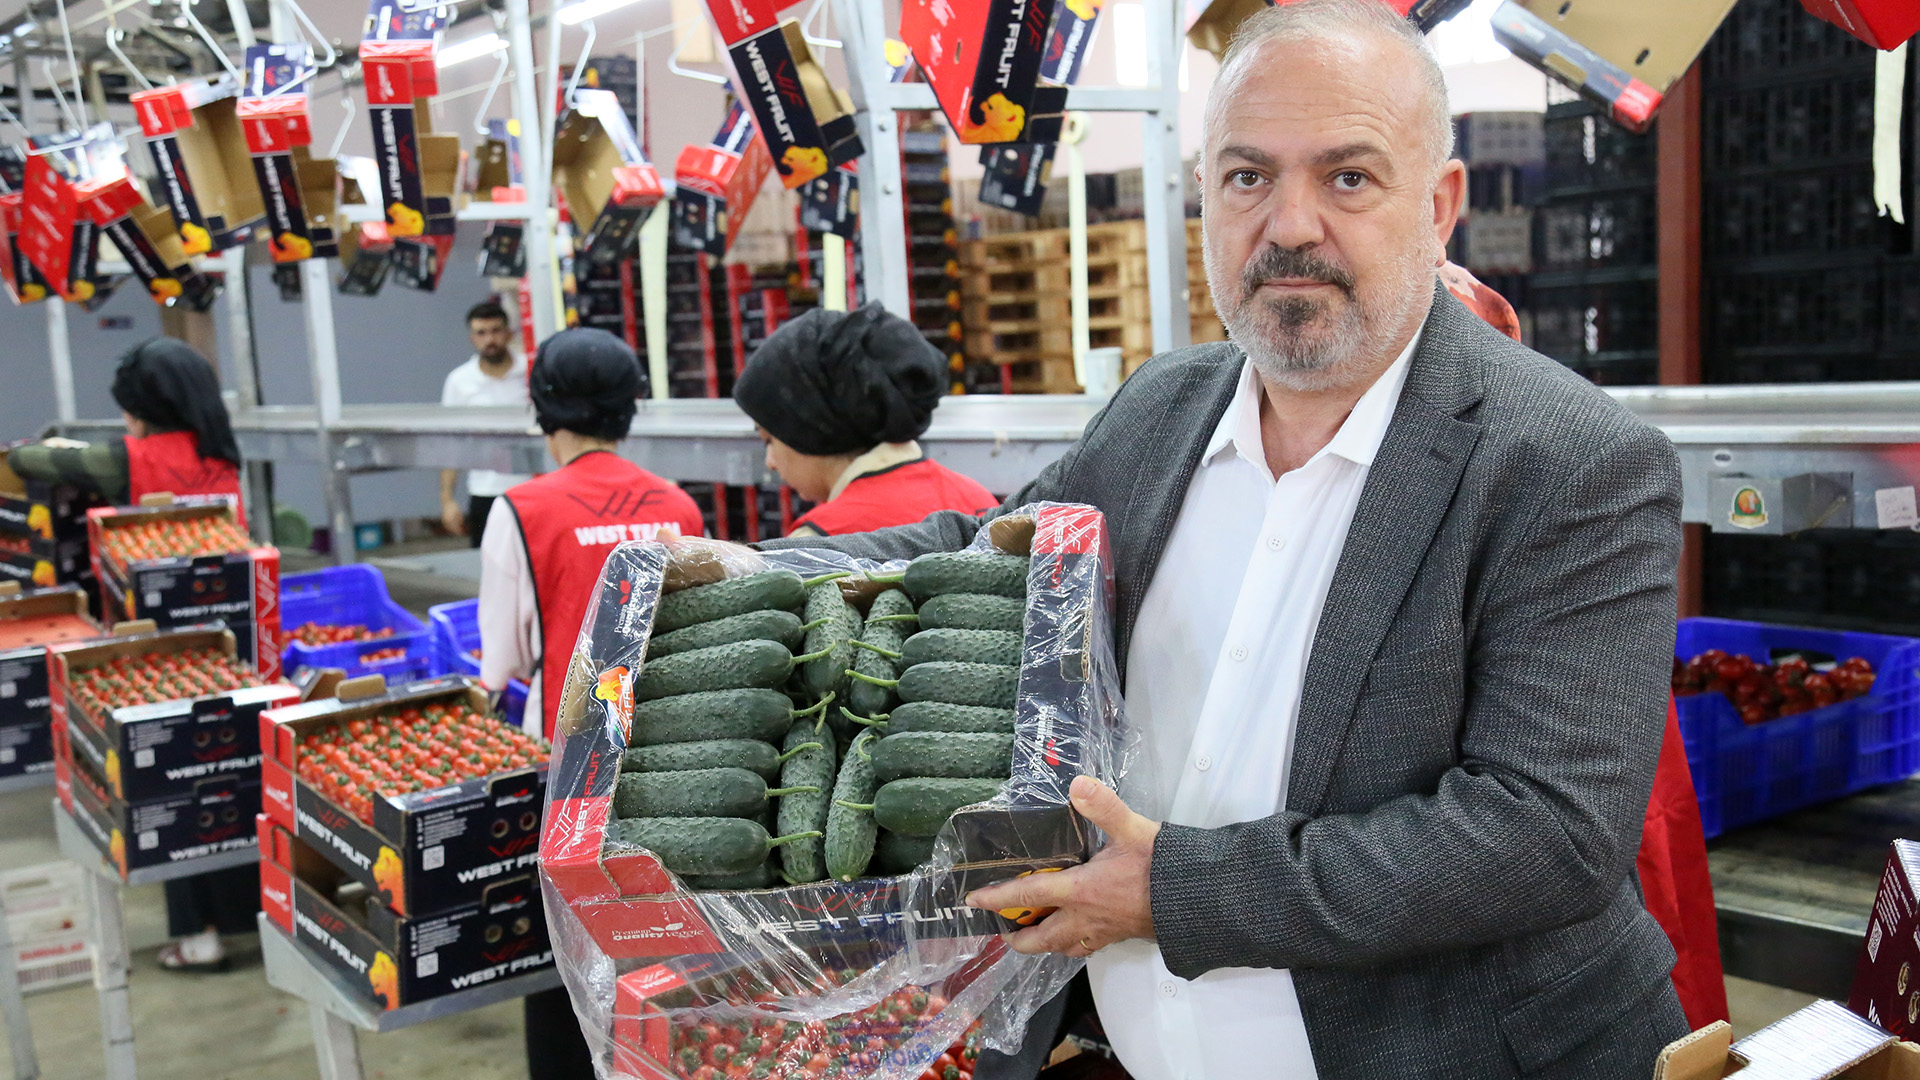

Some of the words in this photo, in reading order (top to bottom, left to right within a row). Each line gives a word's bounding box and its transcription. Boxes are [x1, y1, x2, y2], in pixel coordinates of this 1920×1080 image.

[995, 22, 1021, 89] FRUIT
[745, 40, 776, 94] WEST
[766, 94, 796, 143] FRUIT
[574, 523, 629, 546] WEST
[165, 762, 217, 780] WEST
[571, 798, 588, 847] WEST
[169, 843, 218, 861] WEST
[297, 808, 334, 844] WEST
[332, 836, 372, 871] FRUIT
[457, 858, 516, 884] WEST
[856, 905, 977, 928] FRUIT
[296, 911, 330, 945] WEST
[329, 936, 368, 974] FRUIT
[611, 928, 652, 936] Premium
[613, 931, 665, 941] Quality
[451, 963, 510, 990] WEST
